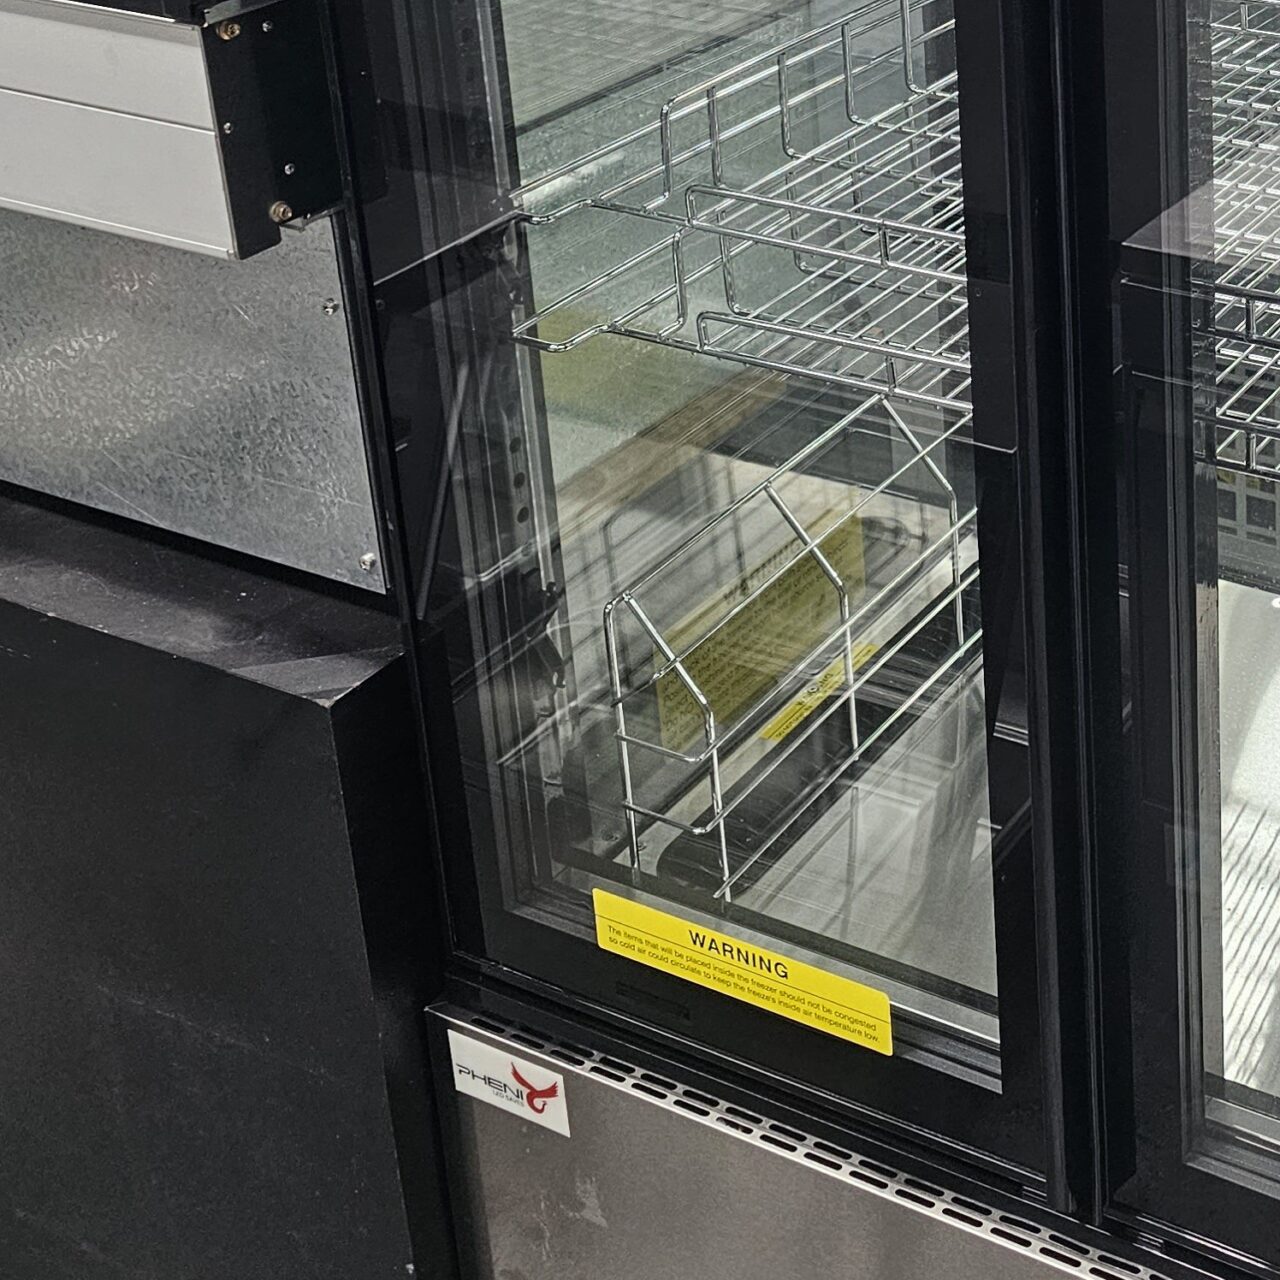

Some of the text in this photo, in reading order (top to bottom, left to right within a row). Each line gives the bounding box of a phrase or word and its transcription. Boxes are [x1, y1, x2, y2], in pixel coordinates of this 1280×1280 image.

[608, 925, 877, 1032] The items that will be placed inside the freezer should not be congested
[608, 936, 618, 945] so
[619, 941, 635, 951] cold
[637, 945, 646, 955] air
[648, 950, 668, 964] could
[670, 959, 702, 976] circulate
[703, 970, 711, 980] to
[712, 974, 732, 988] keep
[733, 981, 746, 993] the
[778, 999, 801, 1014] inside
[802, 1007, 813, 1016] air
[814, 1012, 863, 1036] temperature
[864, 1029, 880, 1043] low.
[688, 929, 789, 979] WARNING
